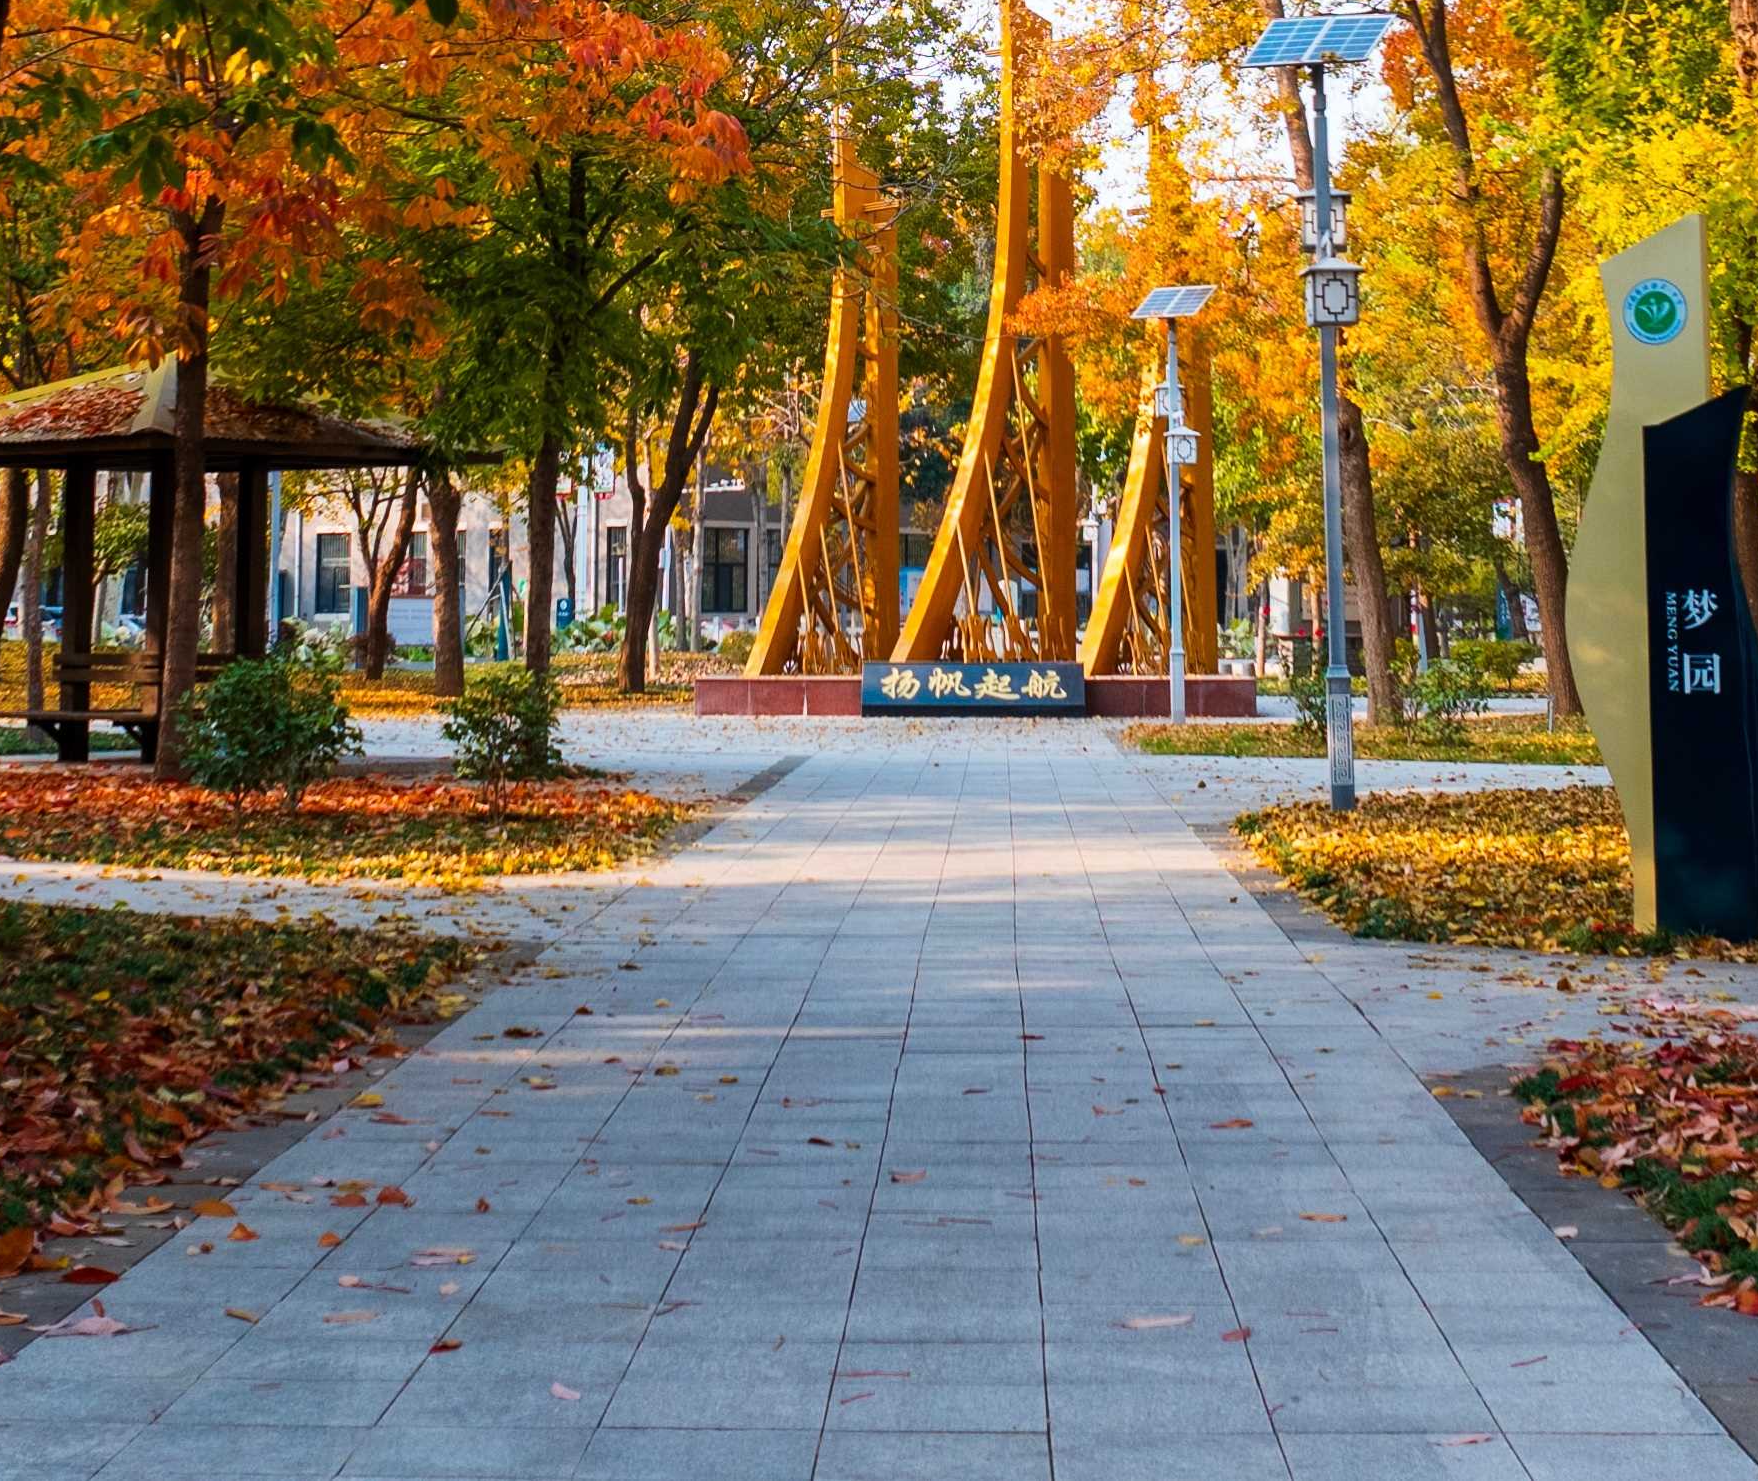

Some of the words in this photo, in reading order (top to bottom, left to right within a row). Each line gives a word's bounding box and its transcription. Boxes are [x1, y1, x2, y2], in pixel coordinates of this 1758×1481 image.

[1666, 591, 1678, 640] MENG
[1682, 588, 1721, 694] 梦园
[880, 667, 1068, 700] 扬帆起航
[1667, 644, 1680, 692] YUAN
